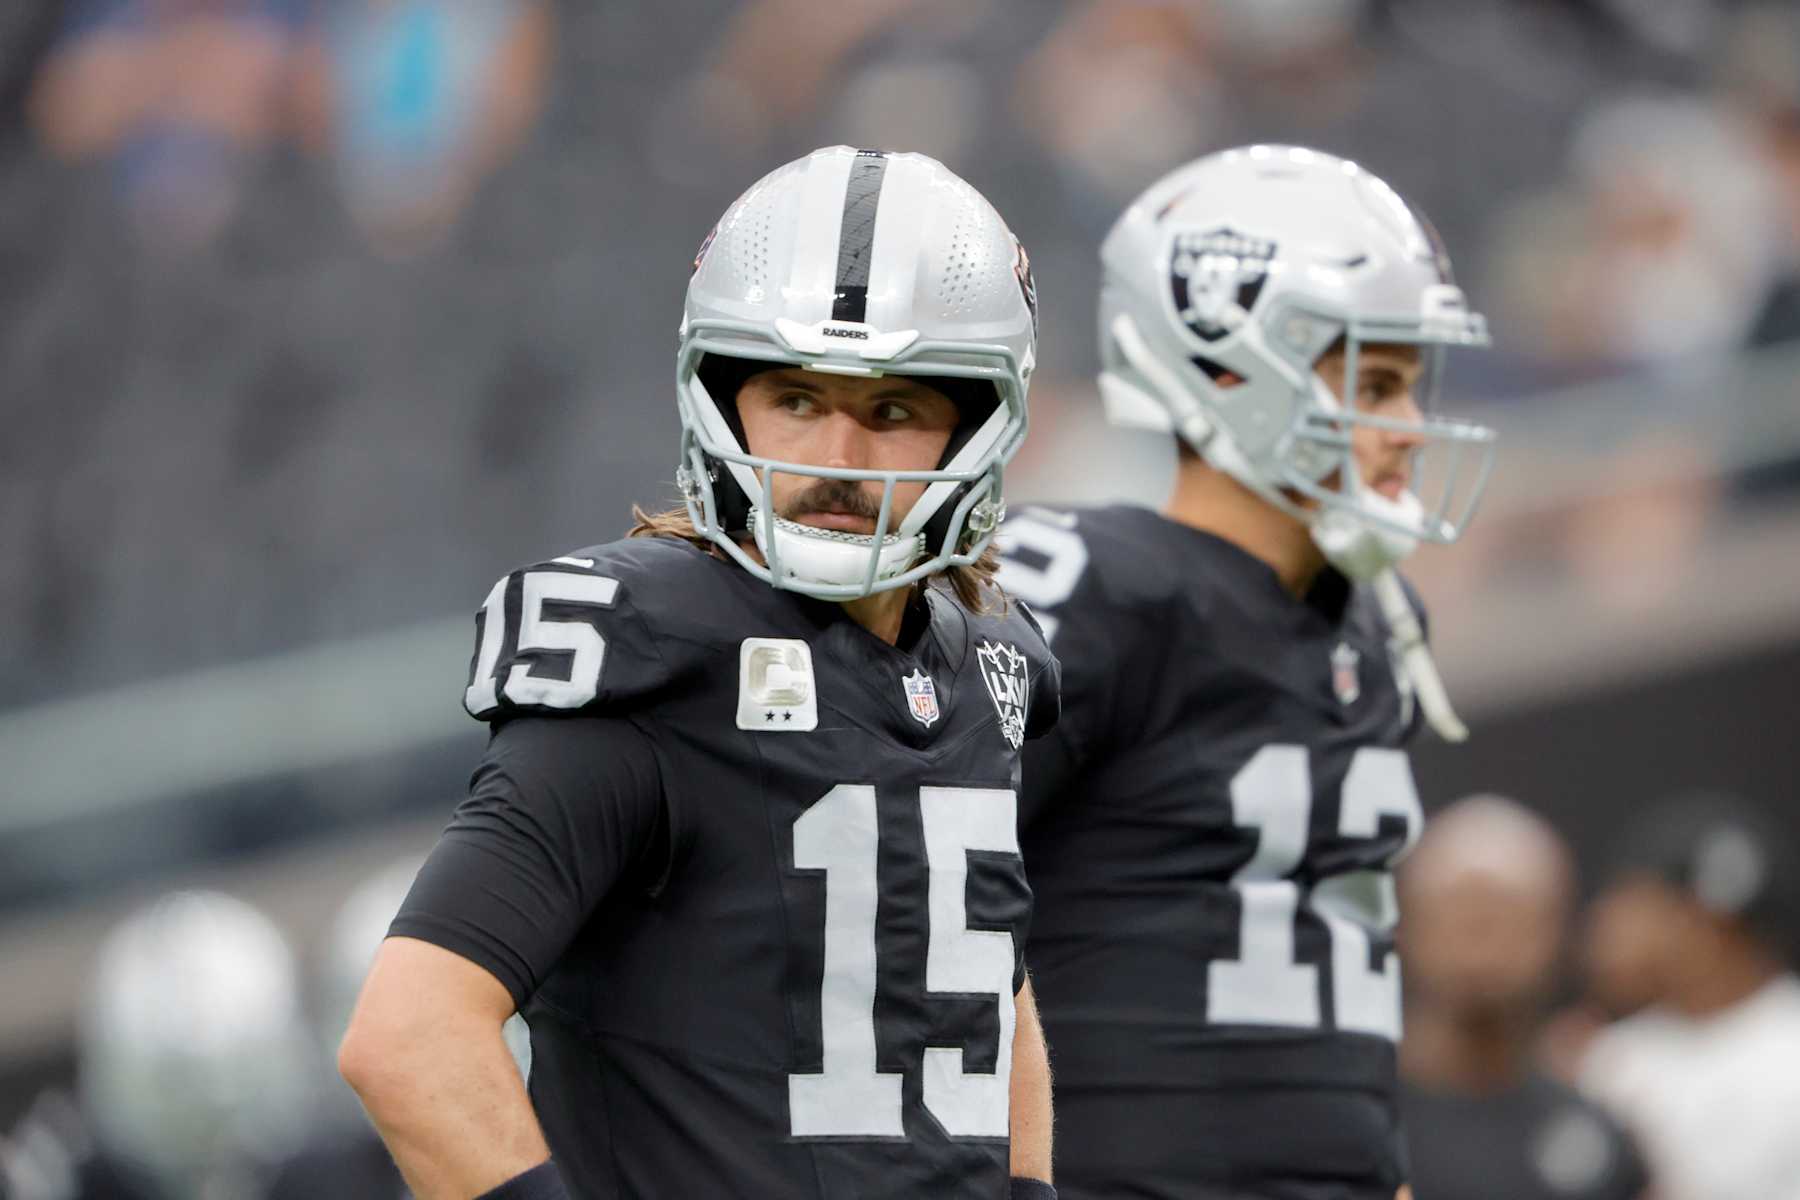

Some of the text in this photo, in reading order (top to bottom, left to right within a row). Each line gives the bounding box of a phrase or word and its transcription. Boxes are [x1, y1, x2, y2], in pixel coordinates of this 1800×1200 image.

[823, 328, 869, 340] RAIDERS
[465, 572, 619, 715] 15
[748, 646, 808, 707] C
[911, 695, 938, 717] NFL
[1206, 744, 1424, 1041] 12
[788, 784, 1018, 1136] 15
